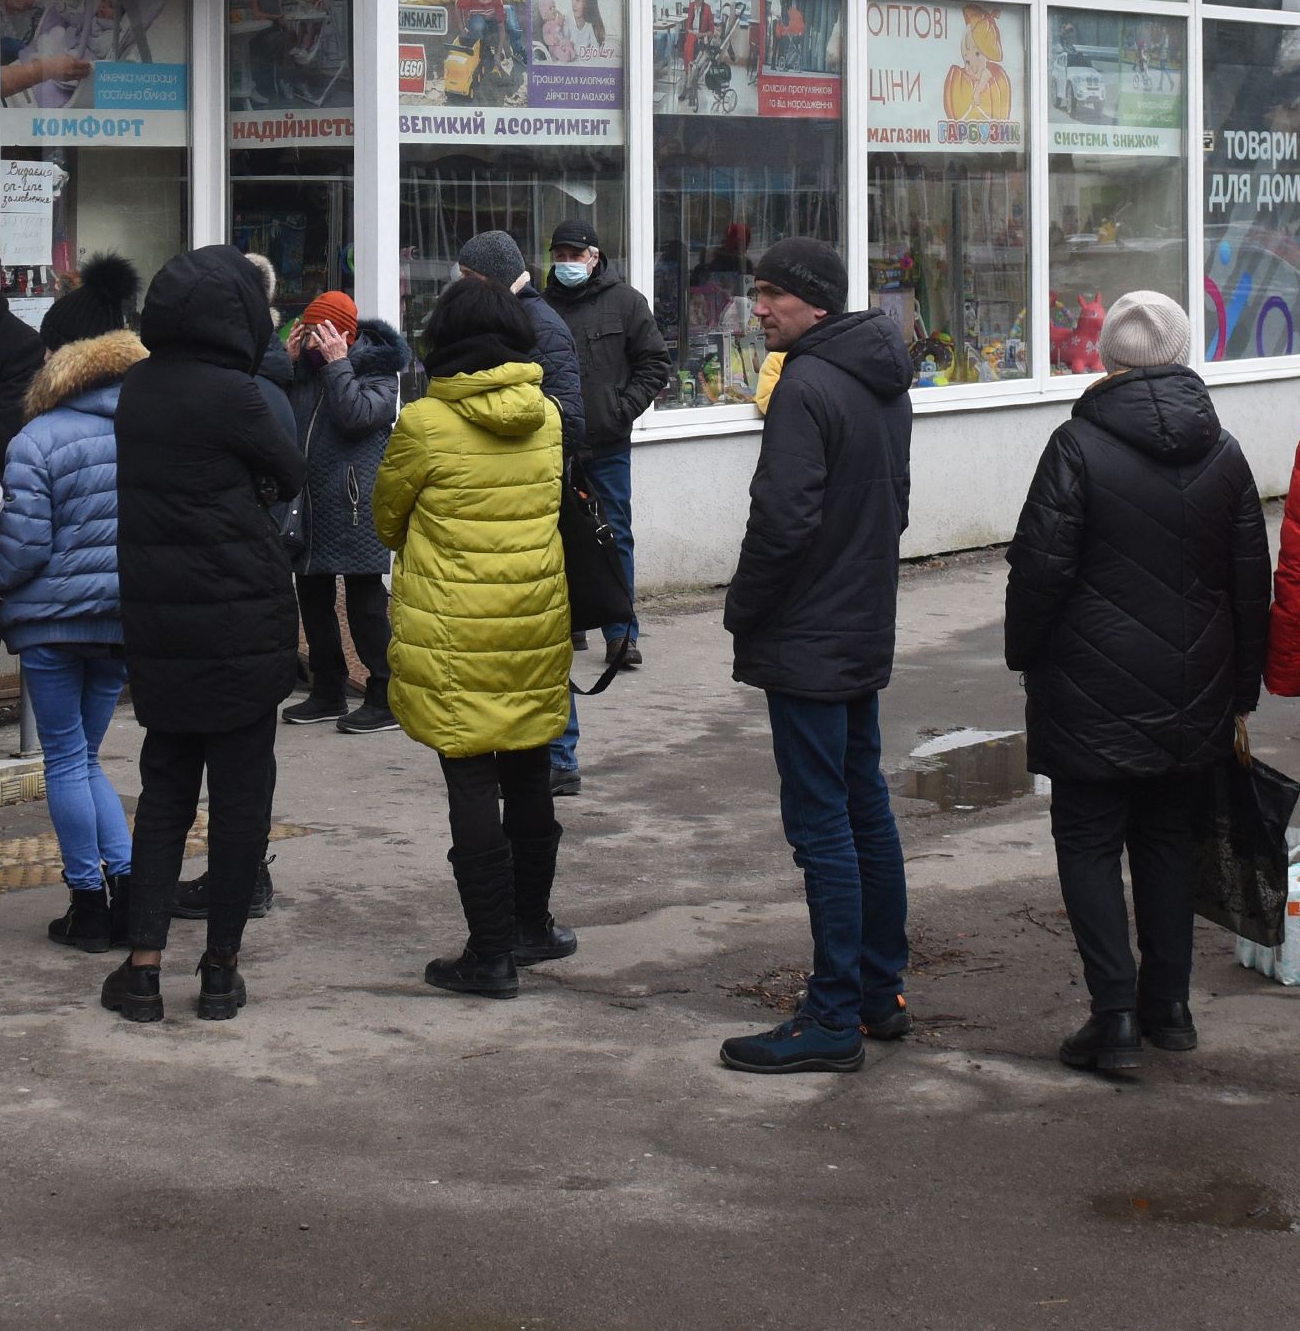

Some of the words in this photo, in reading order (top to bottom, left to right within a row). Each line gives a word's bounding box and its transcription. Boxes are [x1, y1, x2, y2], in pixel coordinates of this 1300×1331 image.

[866, 2, 948, 40] ОПТОВІ
[399, 60, 424, 78] LEGO
[579, 73, 616, 86] хлопчиків
[545, 90, 569, 102] дівчат
[580, 90, 615, 102] малюків
[869, 68, 922, 106] ЦІНИ
[31, 115, 145, 139] КОМФОРТ
[233, 113, 355, 143] НАДІЙНІСТЬ
[398, 111, 486, 135] ВЕЛИКИЙ
[494, 117, 611, 136] АСОРТИМЕНТ
[867, 127, 931, 144] МАГАЗИН
[937, 120, 1021, 145] ГАРБУЗИК
[1053, 131, 1109, 147] СИСТЕМА
[1112, 133, 1160, 149] ЗНИЖОК
[1223, 130, 1298, 170] товари
[1208, 173, 1251, 213] для
